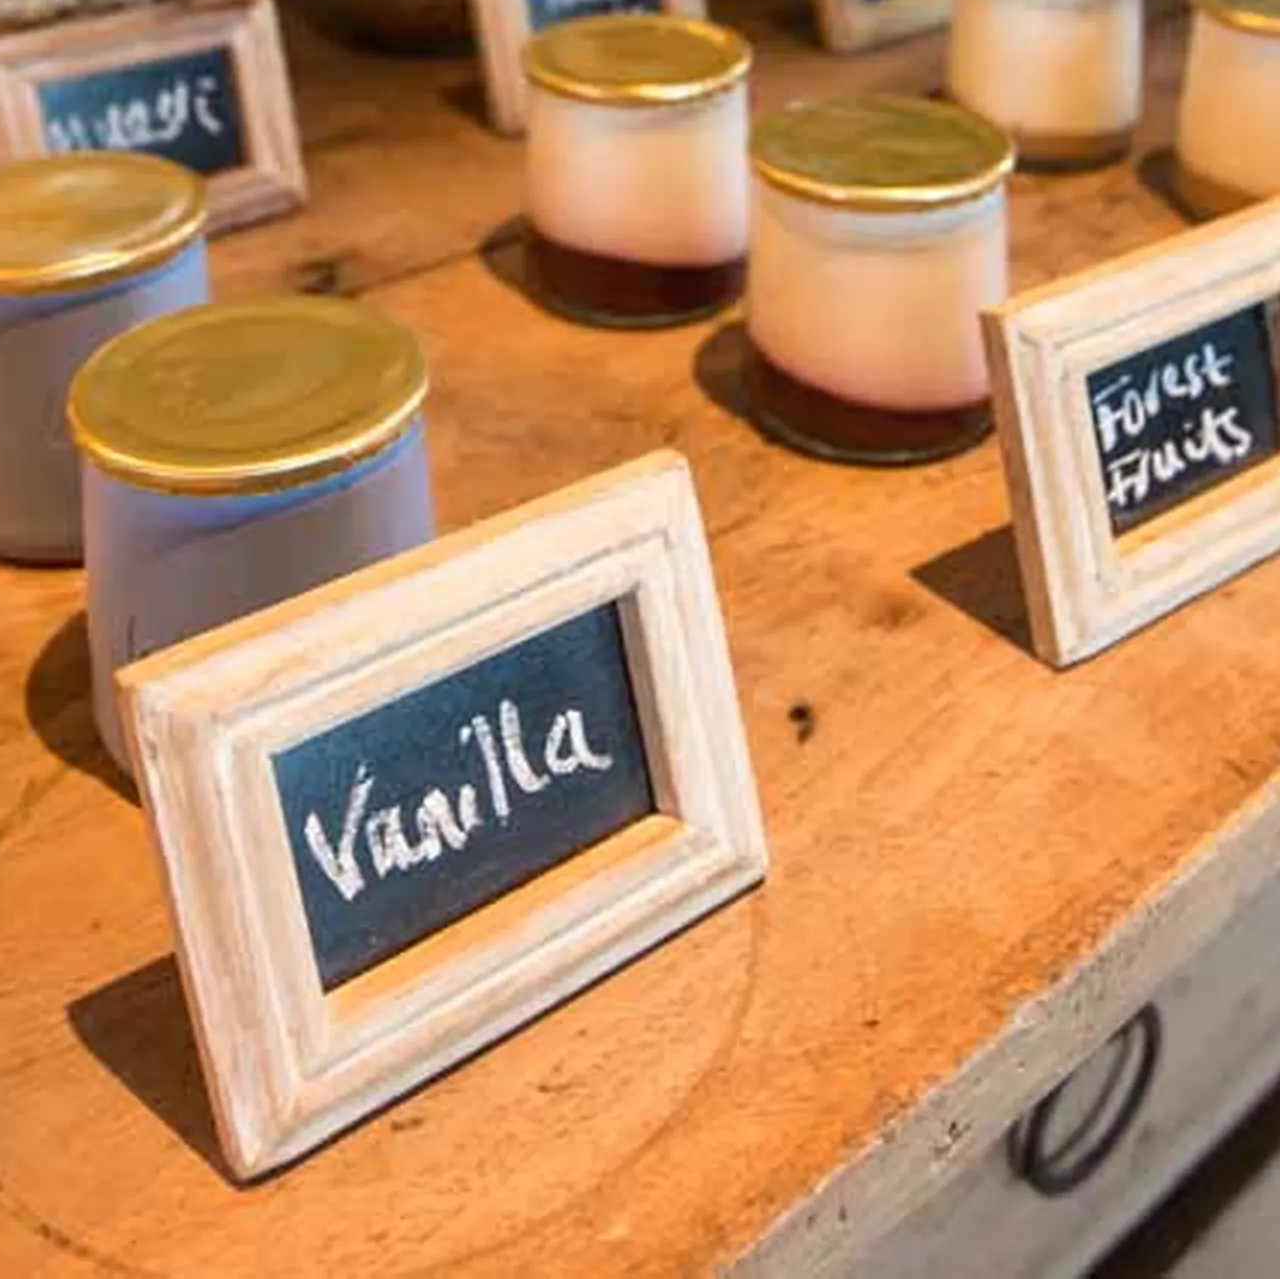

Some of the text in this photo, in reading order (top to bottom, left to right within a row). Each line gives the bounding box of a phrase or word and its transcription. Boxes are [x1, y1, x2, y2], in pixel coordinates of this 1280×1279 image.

[1094, 344, 1234, 451] Forest
[1108, 407, 1253, 507] Fruits
[304, 699, 613, 901] Vanilla
